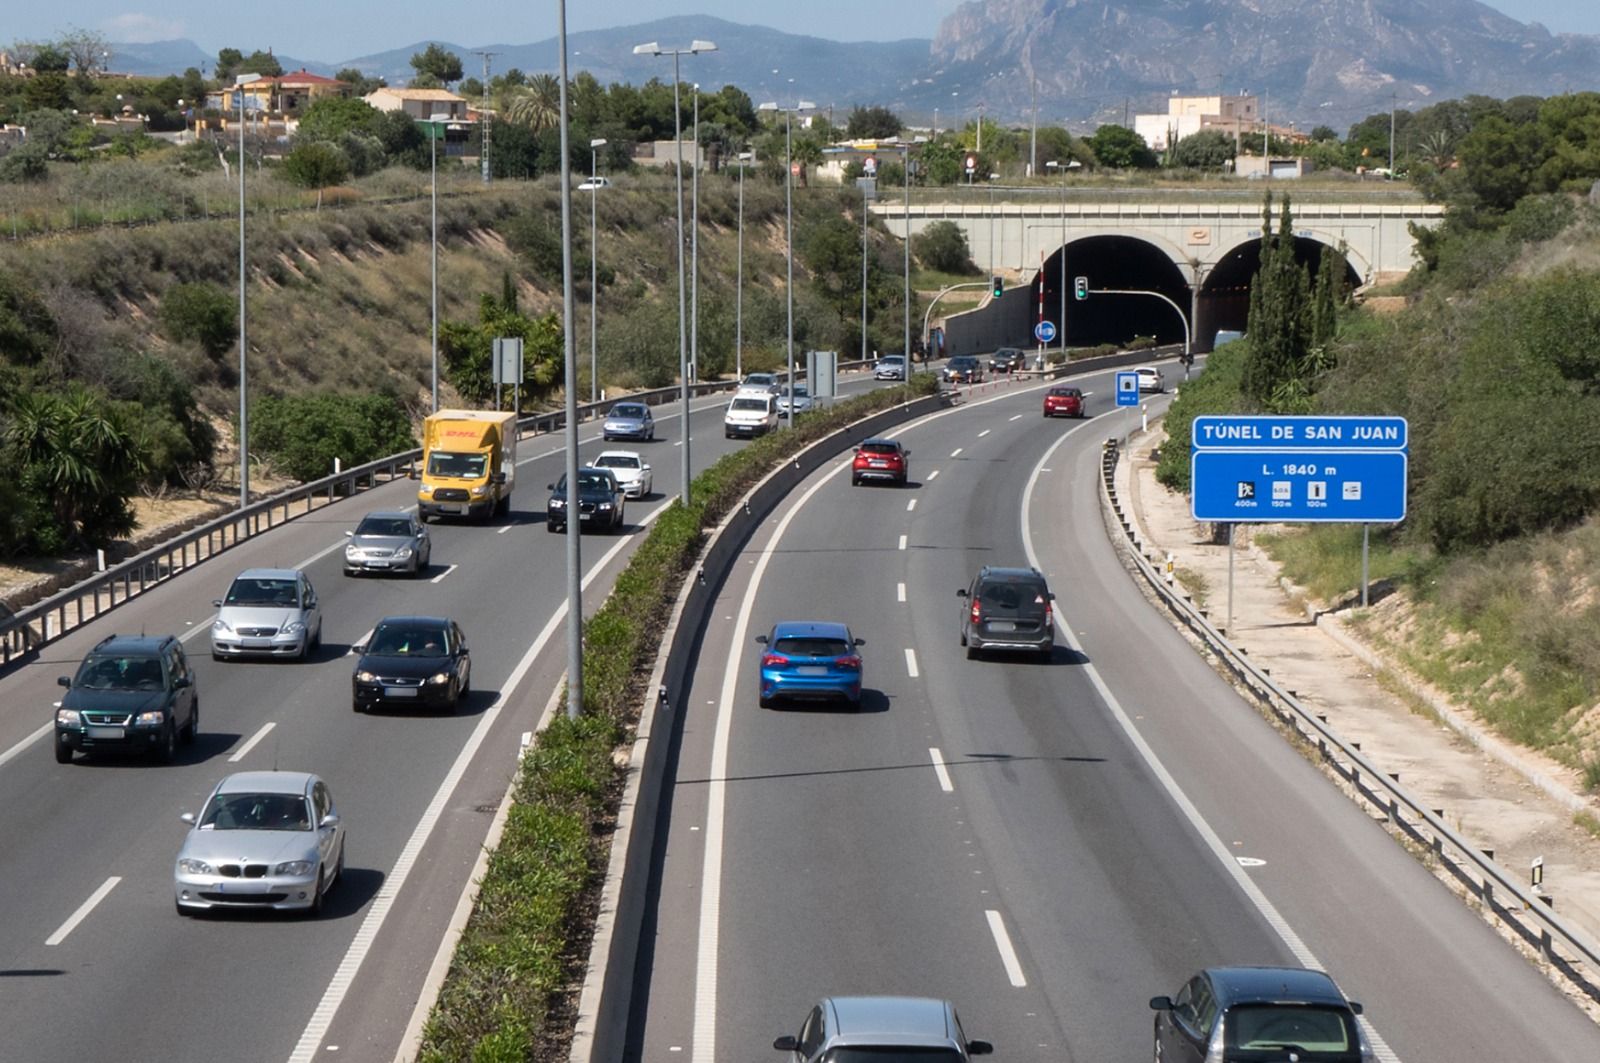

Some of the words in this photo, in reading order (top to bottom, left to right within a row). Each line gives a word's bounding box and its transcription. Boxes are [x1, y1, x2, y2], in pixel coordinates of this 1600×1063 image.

[444, 430, 477, 438] DHL
[1203, 422, 1261, 439] TÚNEL
[1271, 426, 1294, 439] DE
[1305, 426, 1342, 439] SAN
[1352, 426, 1398, 439] JUAN
[1262, 464, 1274, 476] L.
[1282, 464, 1317, 476] 1840
[1325, 467, 1336, 476] m
